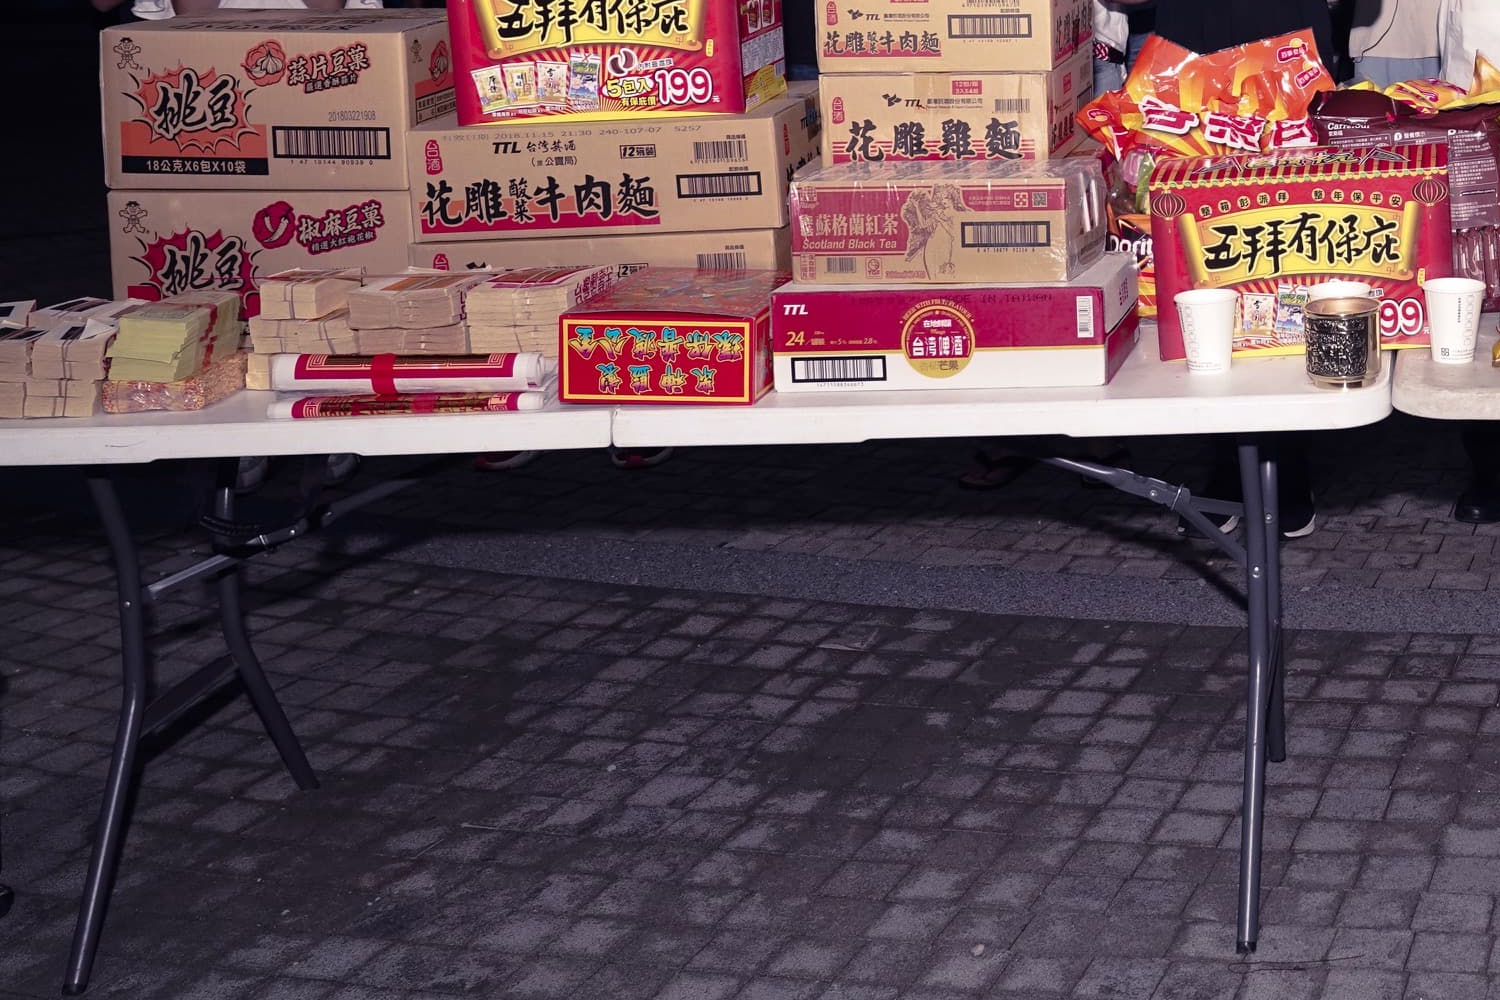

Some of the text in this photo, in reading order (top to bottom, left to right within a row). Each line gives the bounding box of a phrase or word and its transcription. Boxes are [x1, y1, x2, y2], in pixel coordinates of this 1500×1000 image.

[865, 13, 881, 21] TTL
[288, 44, 370, 85] 蒜片豆菓
[606, 79, 652, 97] 5包入
[655, 68, 721, 105] 199 元
[153, 70, 238, 137] 挑豆
[904, 98, 922, 107] TTL
[492, 141, 522, 154] TTL
[845, 117, 1026, 162] 花雕雞麵
[146, 159, 247, 173] 18公克X6包X10袋
[424, 140, 442, 174] 台酒
[422, 172, 660, 227] 花雕酸菜牛肉麵
[1313, 188, 1402, 206] 整年保平安
[299, 203, 382, 243] 椒麻豆菓
[799, 213, 899, 237] 蘇格蘭紅茶
[802, 238, 898, 250] Scotland Black Tea
[1110, 234, 1154, 259] Dorit
[1202, 211, 1402, 275] 五拜有保庇
[162, 229, 245, 295] 挑豆
[783, 303, 809, 316] TTL
[1380, 299, 1423, 337] 99
[923, 318, 953, 328] 在地
[784, 330, 806, 347] 24
[912, 335, 964, 357] 台灣啤酒
